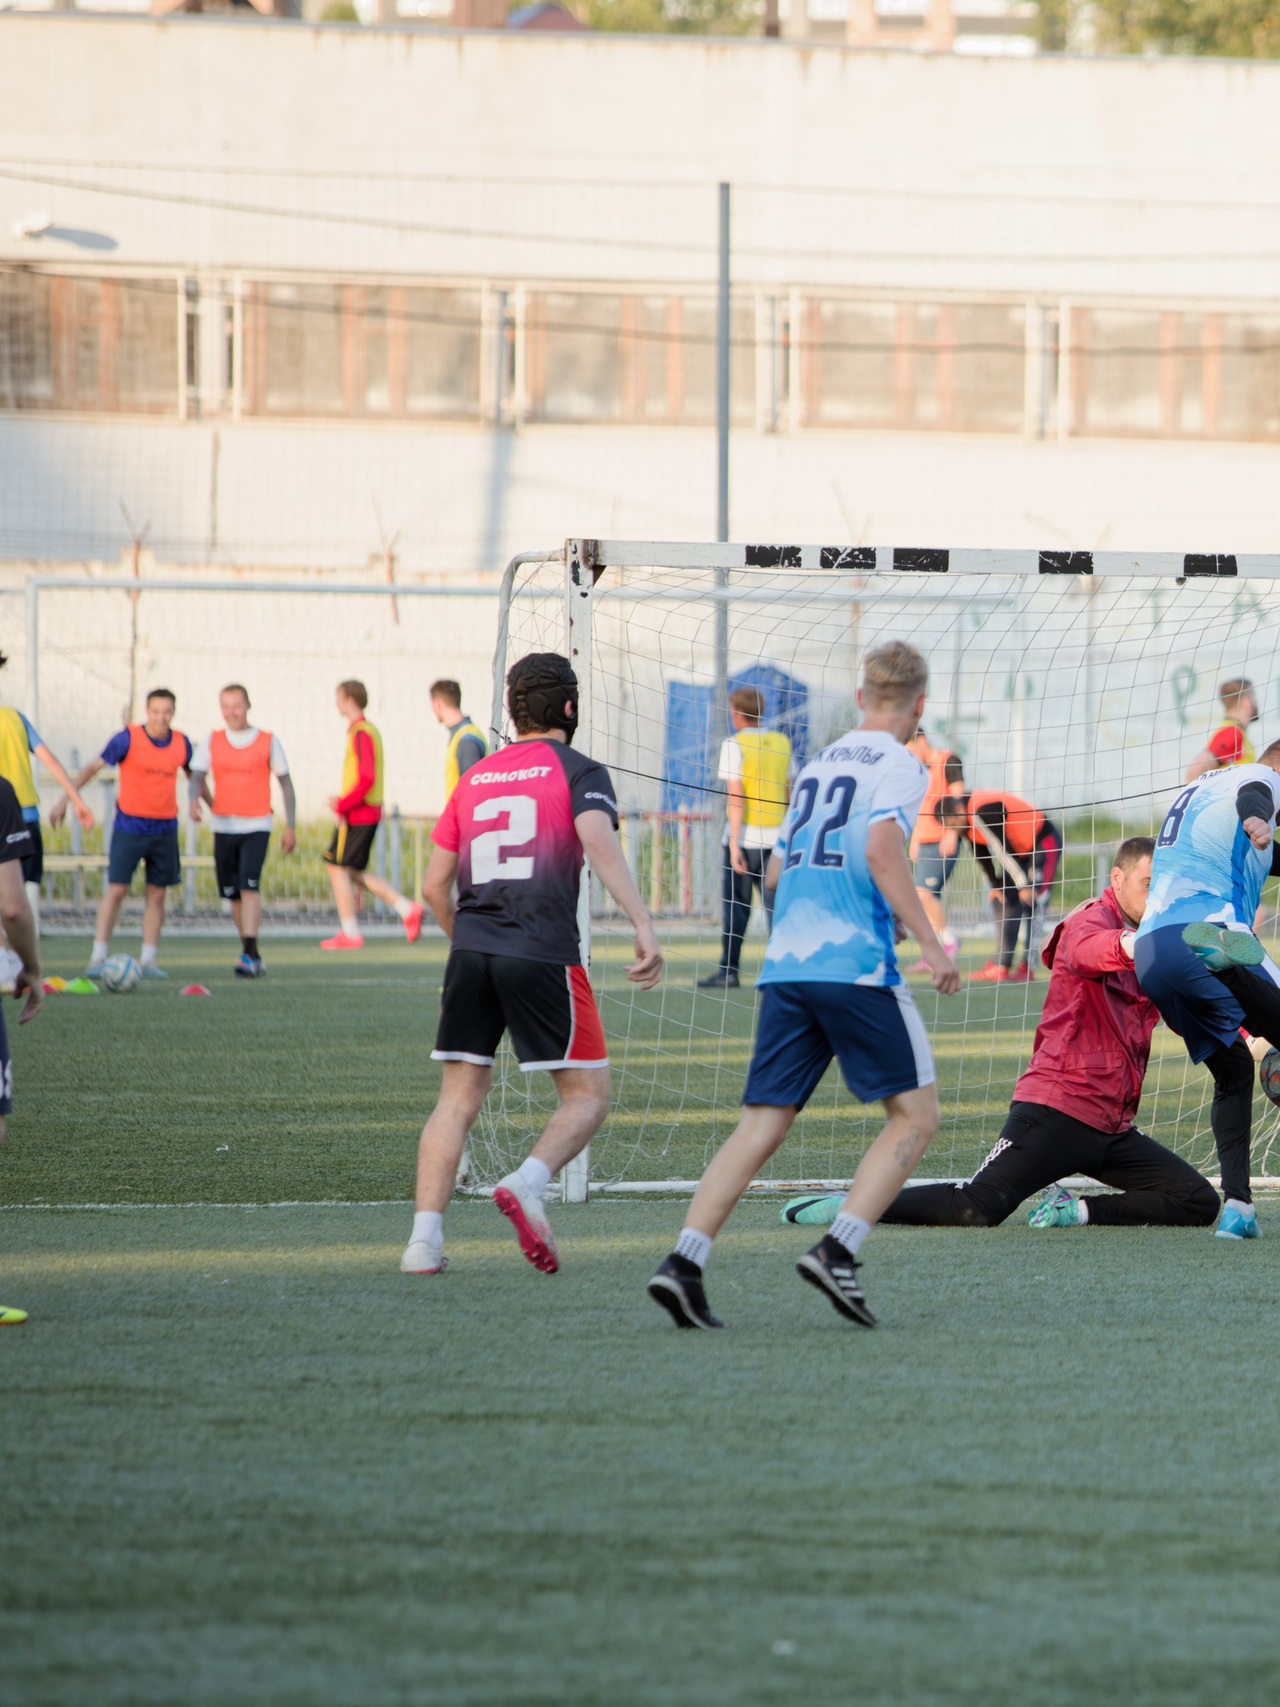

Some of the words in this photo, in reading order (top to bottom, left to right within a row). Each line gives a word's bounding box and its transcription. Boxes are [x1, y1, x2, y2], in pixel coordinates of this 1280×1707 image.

[826, 745, 885, 765] КРЫЛЬЯ
[471, 795, 537, 885] 2
[784, 775, 857, 872] 22
[1157, 784, 1200, 848] 8
